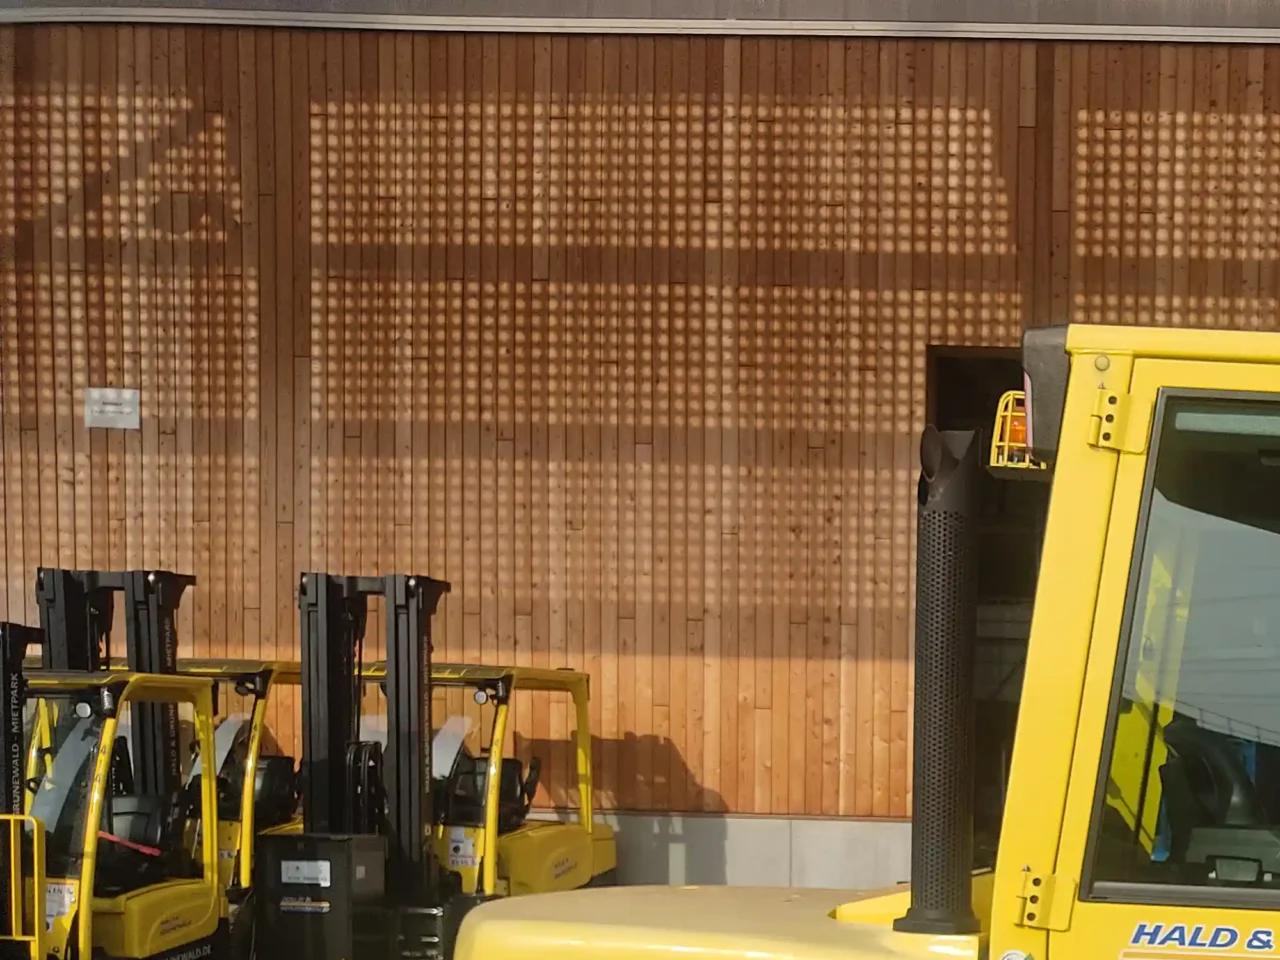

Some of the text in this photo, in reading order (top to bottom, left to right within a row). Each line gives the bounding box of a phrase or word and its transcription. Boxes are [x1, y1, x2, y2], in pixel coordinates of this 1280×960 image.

[10, 673, 20, 733] MIETPARK
[1131, 923, 1275, 950] HALD &
